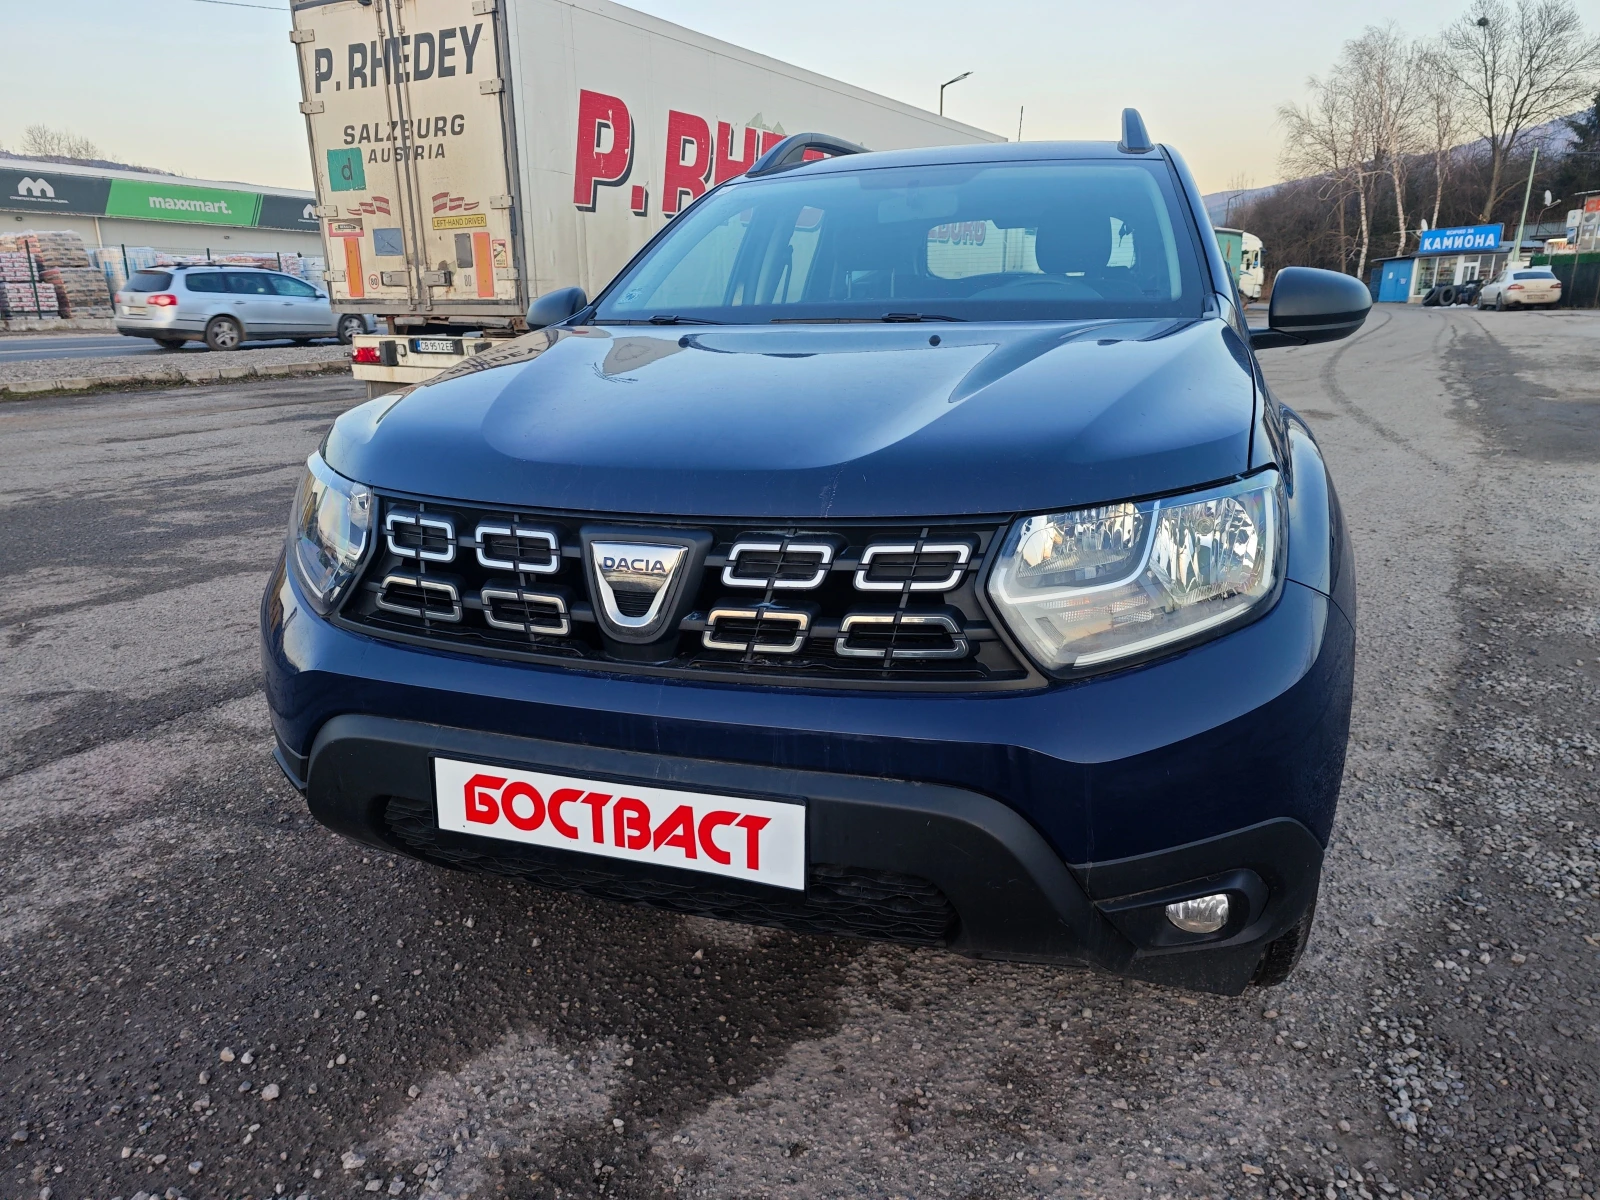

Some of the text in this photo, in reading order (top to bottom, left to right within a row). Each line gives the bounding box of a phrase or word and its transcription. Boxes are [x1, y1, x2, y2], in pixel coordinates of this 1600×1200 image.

[343, 114, 465, 145] SALZBURG
[368, 143, 446, 164] AUSTRIA
[341, 158, 353, 181] d
[433, 216, 485, 228] LEFT-HAND DRIVER
[1423, 233, 1495, 251] КАМИОНА
[370, 277, 378, 285] 80
[464, 275, 472, 287] 80
[603, 556, 666, 573] DACIA
[464, 773, 772, 871] БОСТВАСТ
